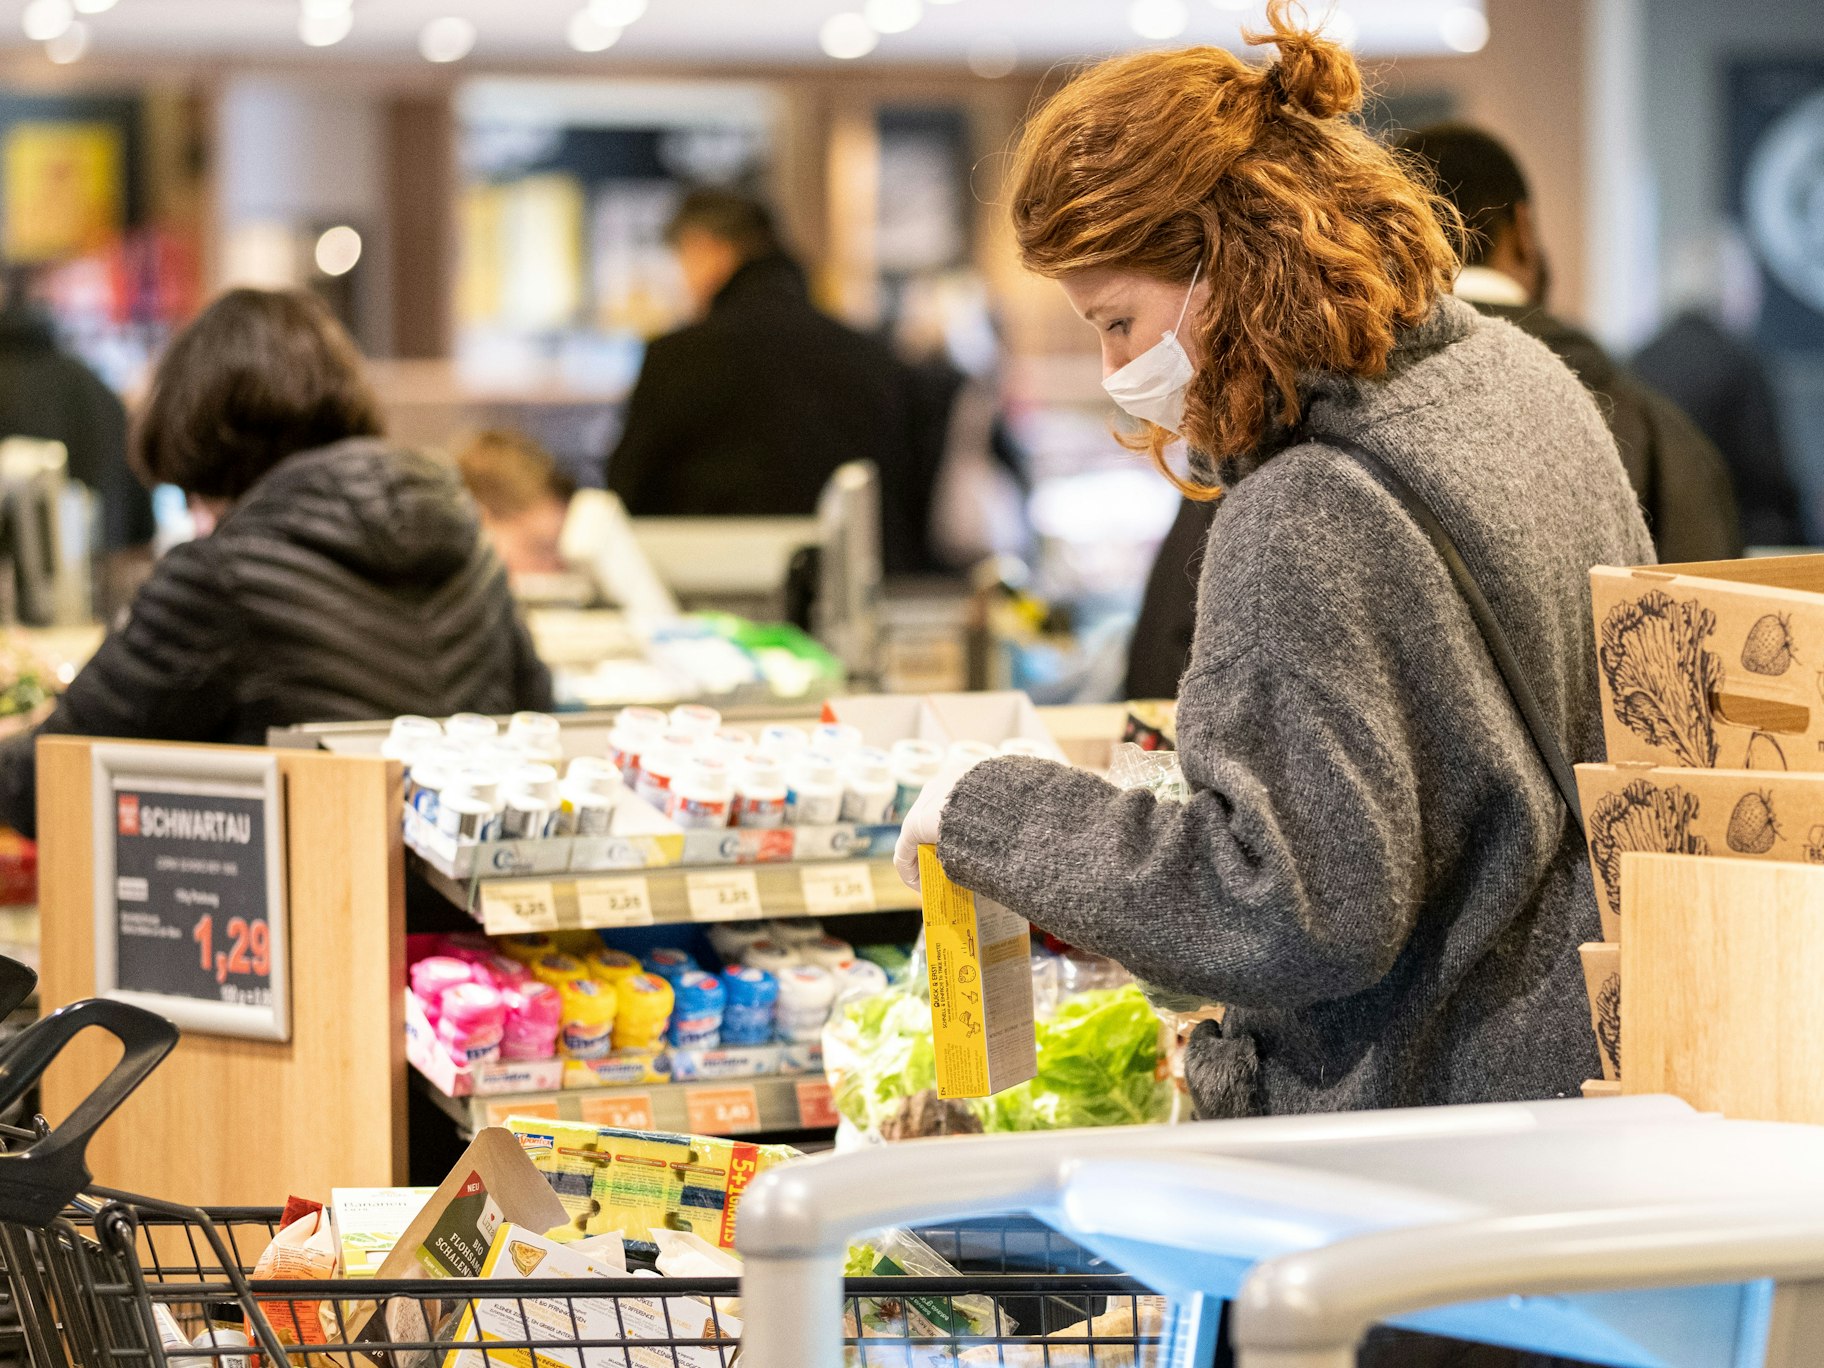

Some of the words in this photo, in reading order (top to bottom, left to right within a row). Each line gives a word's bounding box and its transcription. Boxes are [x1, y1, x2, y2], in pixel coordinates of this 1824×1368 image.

[141, 806, 251, 844] SCHWARTAU
[194, 912, 270, 984] 1,29
[941, 1087, 946, 1096] EN
[517, 1134, 551, 1149] Spontex
[467, 1183, 479, 1192] NEU
[450, 1233, 481, 1276] FLOHSAME
[473, 1239, 483, 1256] BIO
